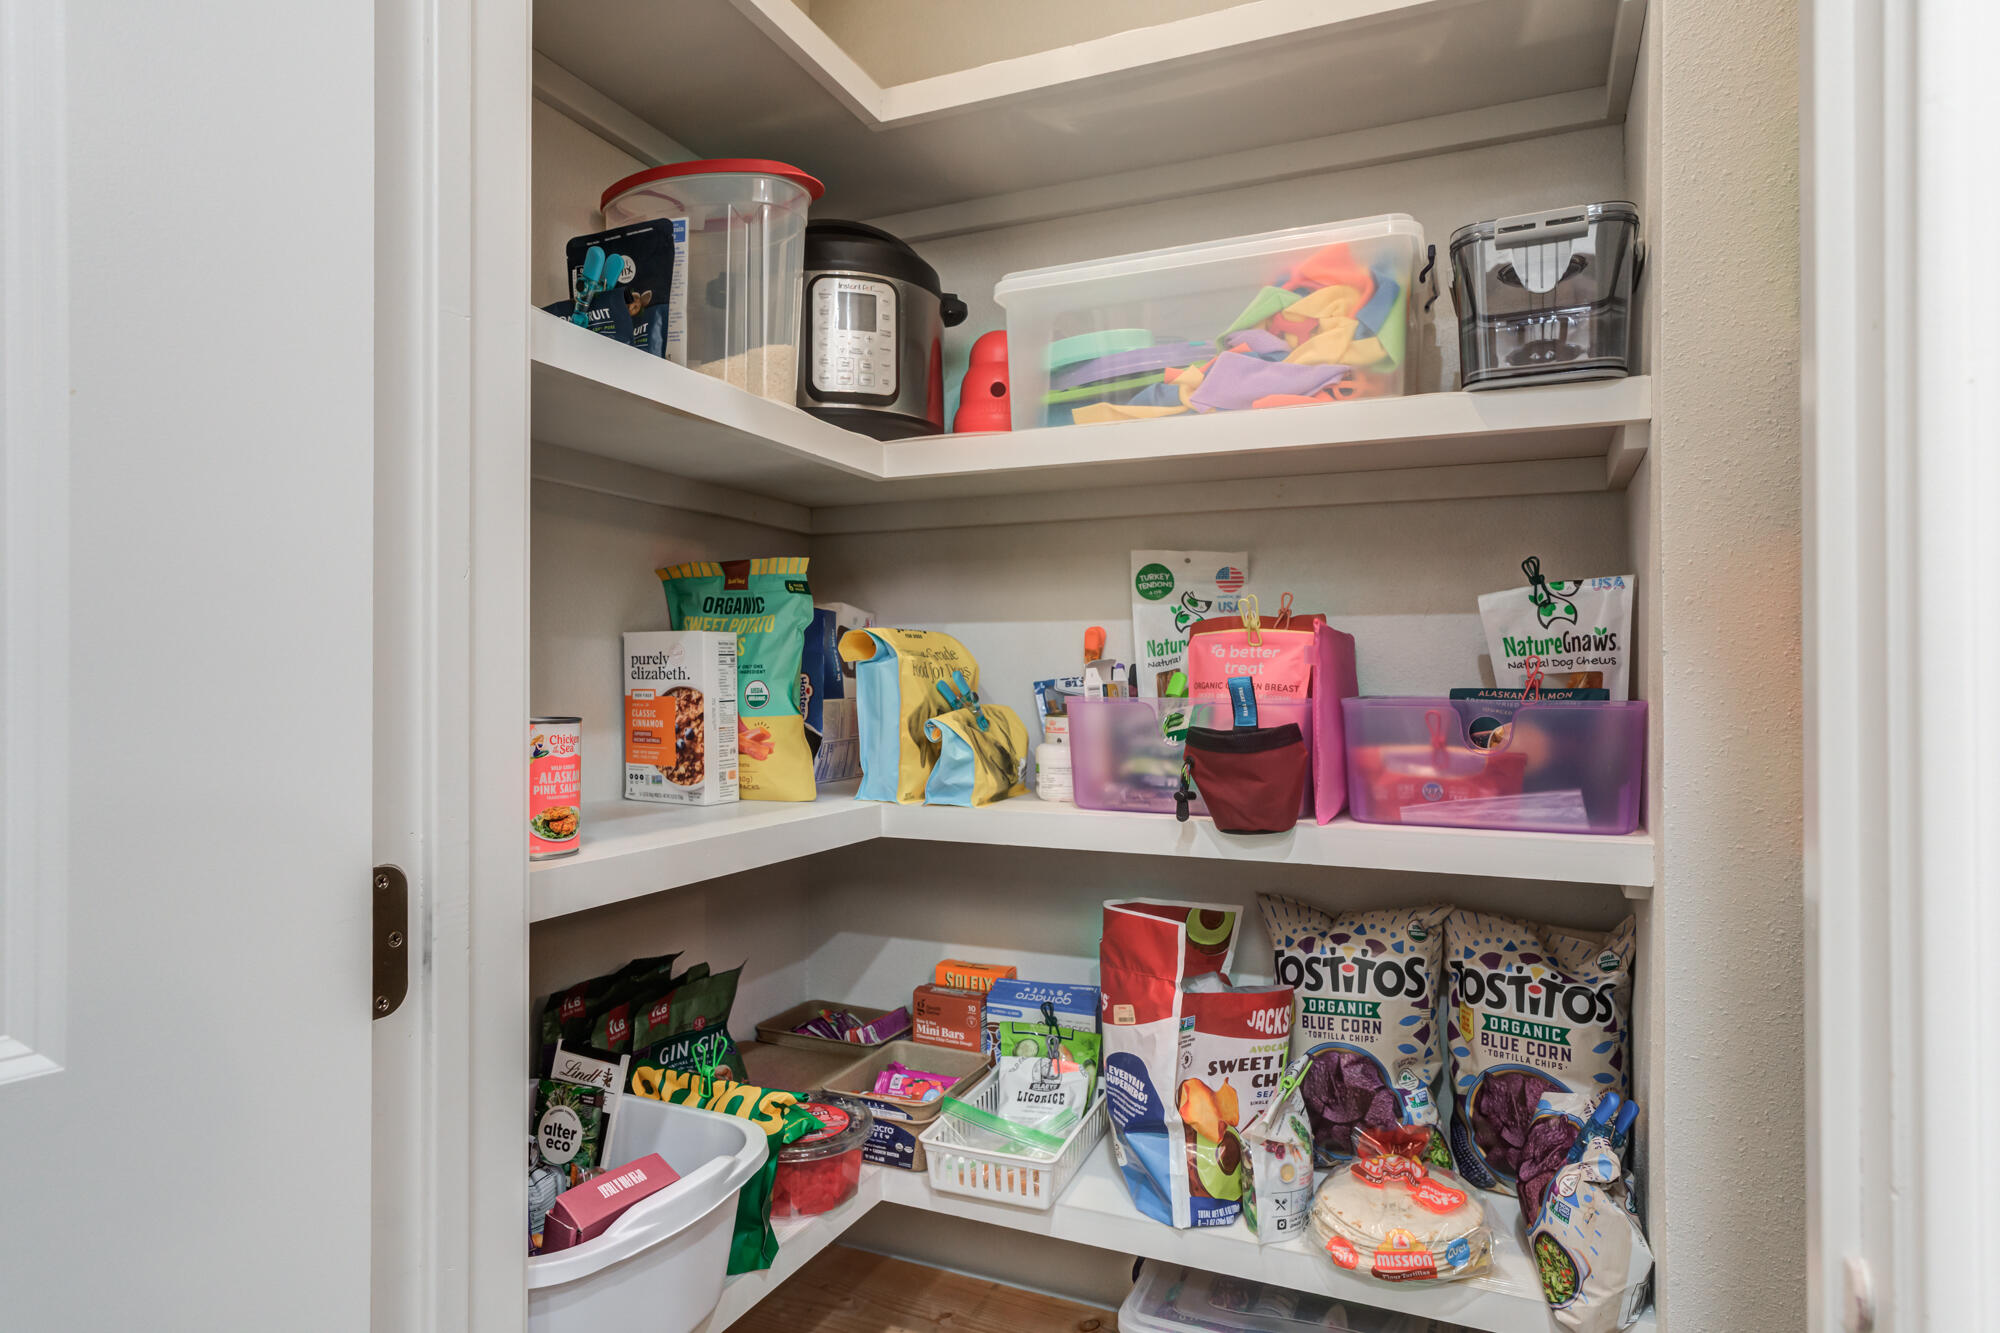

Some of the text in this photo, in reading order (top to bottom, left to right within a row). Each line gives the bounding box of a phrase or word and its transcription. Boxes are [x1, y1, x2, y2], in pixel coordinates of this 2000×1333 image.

[1139, 573, 1170, 582] TURKEY
[1591, 576, 1625, 590] USA
[1138, 581, 1173, 591] TENDONS
[702, 596, 765, 615] ORGANIC
[728, 615, 776, 637] POTATO
[1230, 644, 1281, 659] better
[631, 650, 670, 669] purely
[1552, 658, 1574, 670] Dog
[1576, 656, 1617, 666] Chews
[1225, 661, 1265, 675] treat
[1193, 682, 1223, 691] ORGANIC
[1264, 683, 1300, 694] BREAST
[632, 709, 657, 718] CLASSIC
[632, 719, 664, 728] CINNAMON
[560, 744, 575, 755] Sea
[533, 784, 557, 796] PINK
[1015, 991, 1073, 1006] gomacro
[967, 1005, 977, 1014] 10
[1308, 999, 1373, 1016] ORGANIC
[916, 1023, 965, 1041] Mini Bars
[1302, 1015, 1382, 1035] BLUE CORN
[1490, 1016, 1562, 1042] ORGANIC
[1308, 1030, 1376, 1043] TORTILLA CHIPS
[660, 1041, 689, 1065] GIN
[1481, 1032, 1572, 1062] BLUE CORN
[1207, 1056, 1274, 1077] SWEET
[1488, 1048, 1564, 1071] TORTILLA CHIPS
[1108, 1064, 1145, 1092] EVERYDAY
[1016, 1090, 1065, 1106] LICORICE
[543, 1123, 578, 1141] alter
[546, 1137, 571, 1153] eco
